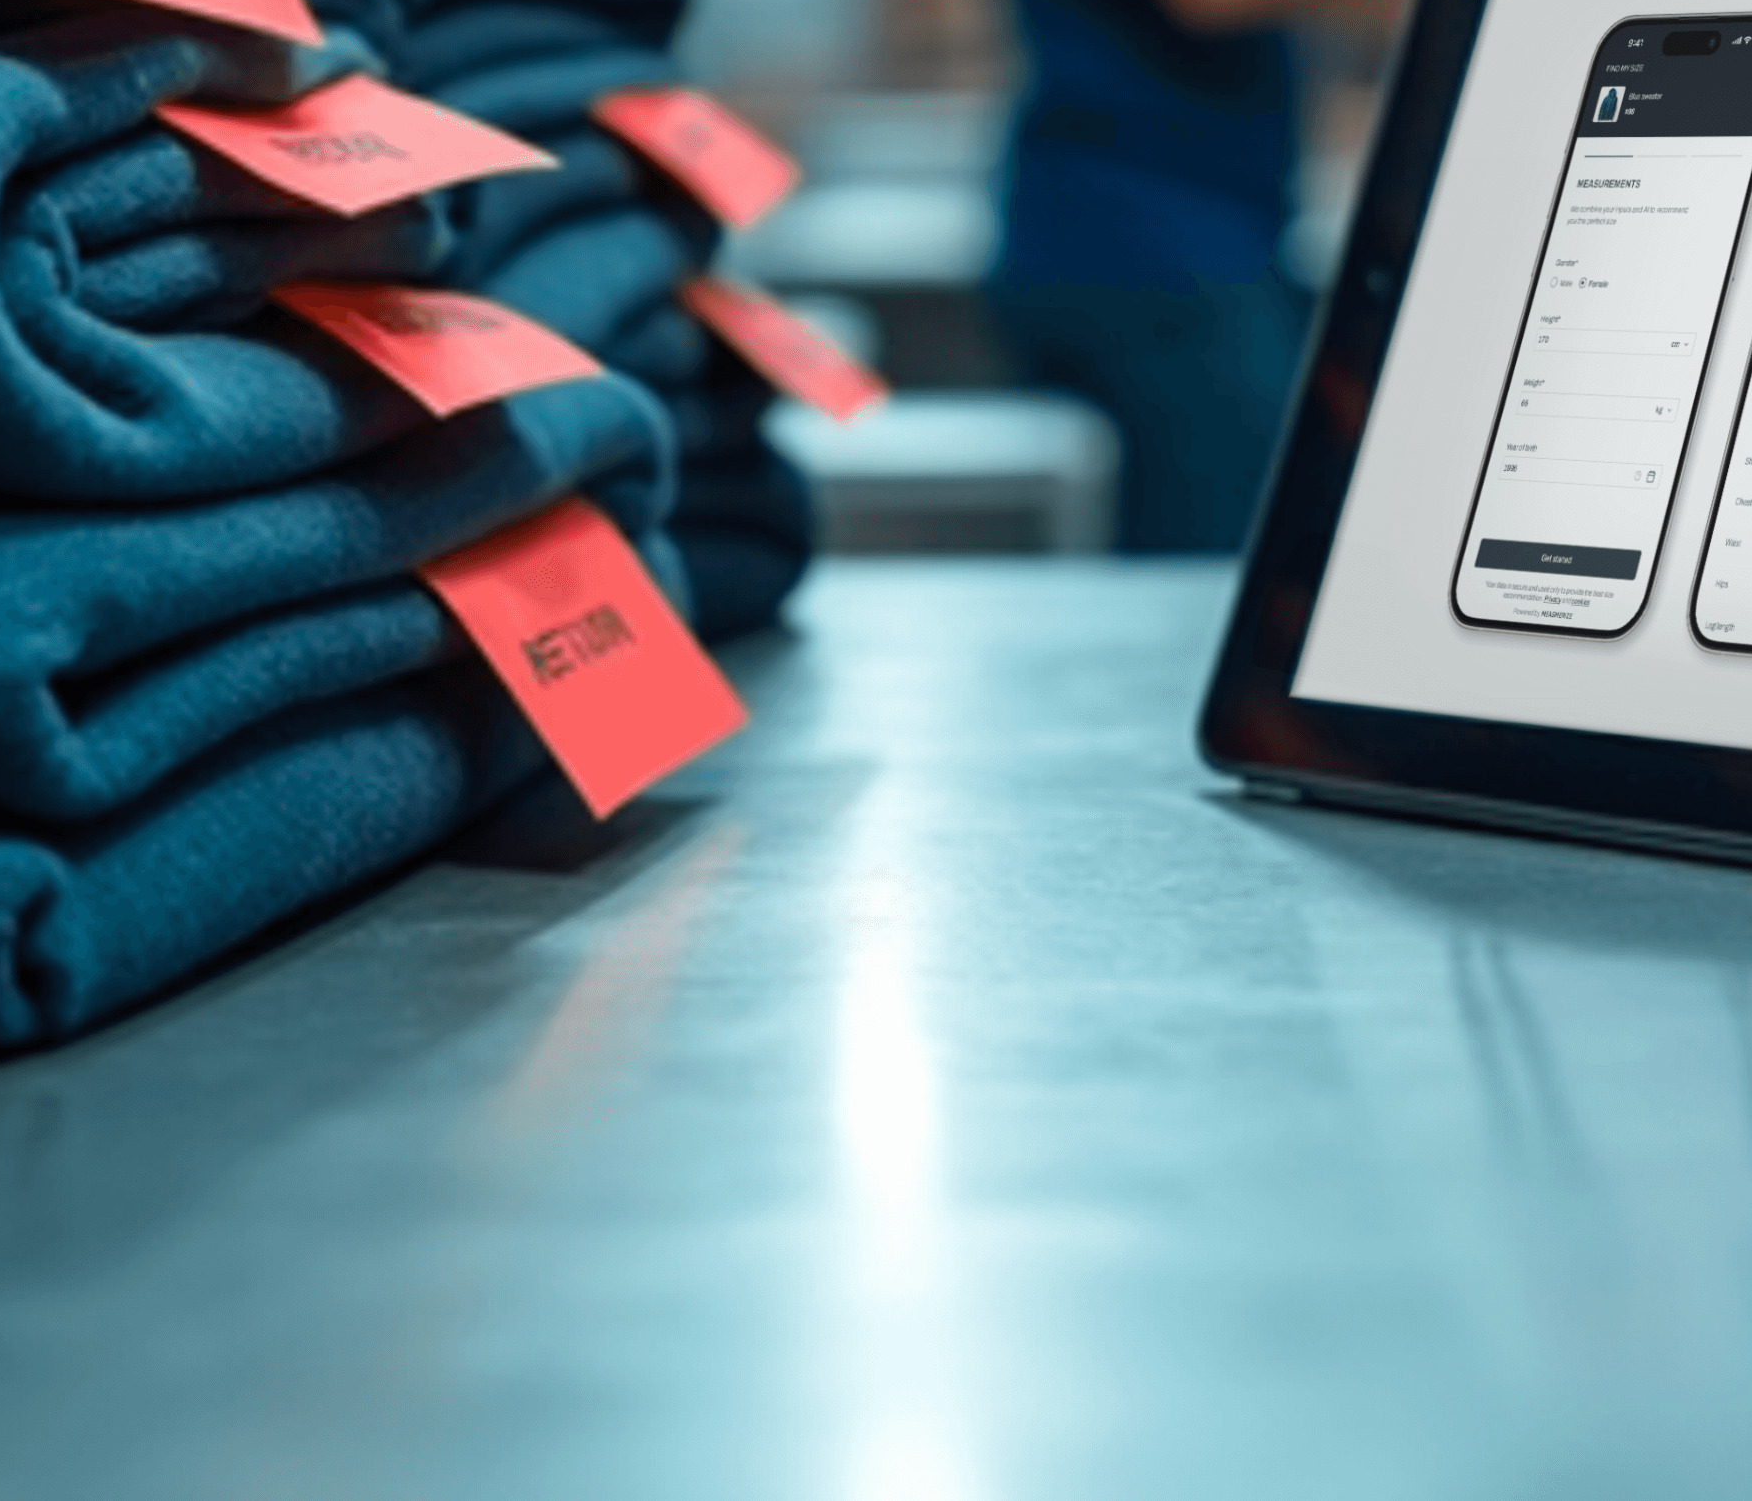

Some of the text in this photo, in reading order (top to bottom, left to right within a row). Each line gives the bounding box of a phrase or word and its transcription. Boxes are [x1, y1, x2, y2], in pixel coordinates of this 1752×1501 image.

[1628, 39, 1644, 47] 9:41
[1606, 64, 1645, 72] FIND MY SIZE
[1576, 179, 1641, 189] MEASUREMENTS
[1541, 553, 1573, 564] Get started
[1715, 579, 1729, 589] Hips
